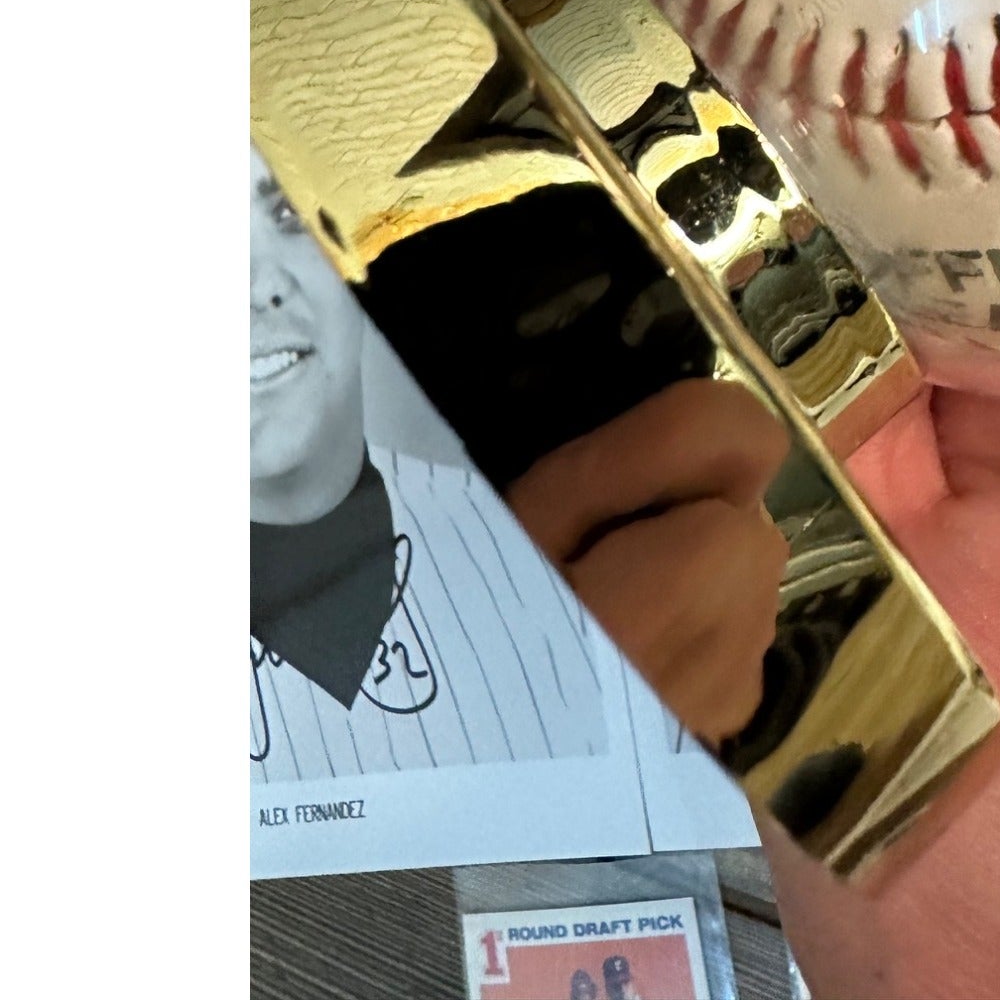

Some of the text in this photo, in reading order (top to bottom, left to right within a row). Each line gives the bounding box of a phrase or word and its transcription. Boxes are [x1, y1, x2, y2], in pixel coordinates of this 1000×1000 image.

[259, 800, 366, 827] ALEX FERNANDEZ
[508, 924, 567, 941] ROUND
[574, 918, 632, 937] DRAFT
[638, 914, 684, 932] PICK
